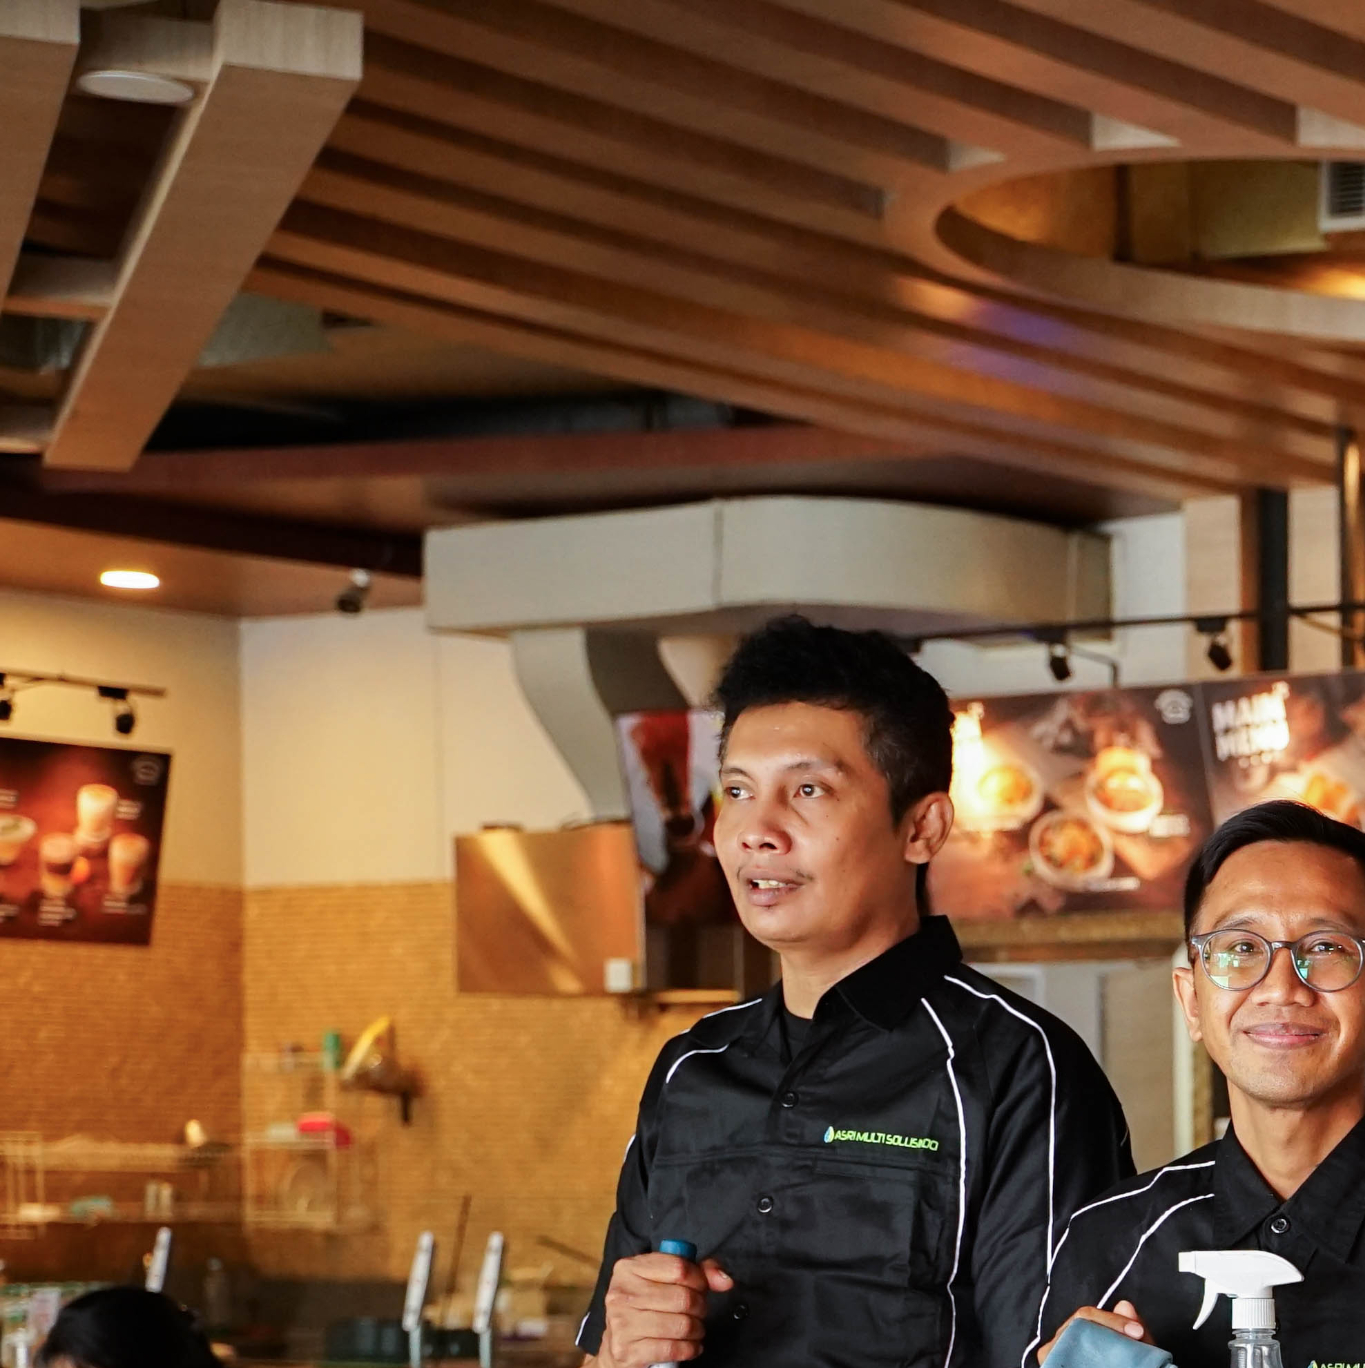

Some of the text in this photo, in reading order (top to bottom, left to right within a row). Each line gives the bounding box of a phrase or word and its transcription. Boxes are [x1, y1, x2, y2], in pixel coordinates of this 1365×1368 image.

[834, 1130, 939, 1151] ASRI MULTI SOLUSINDO
